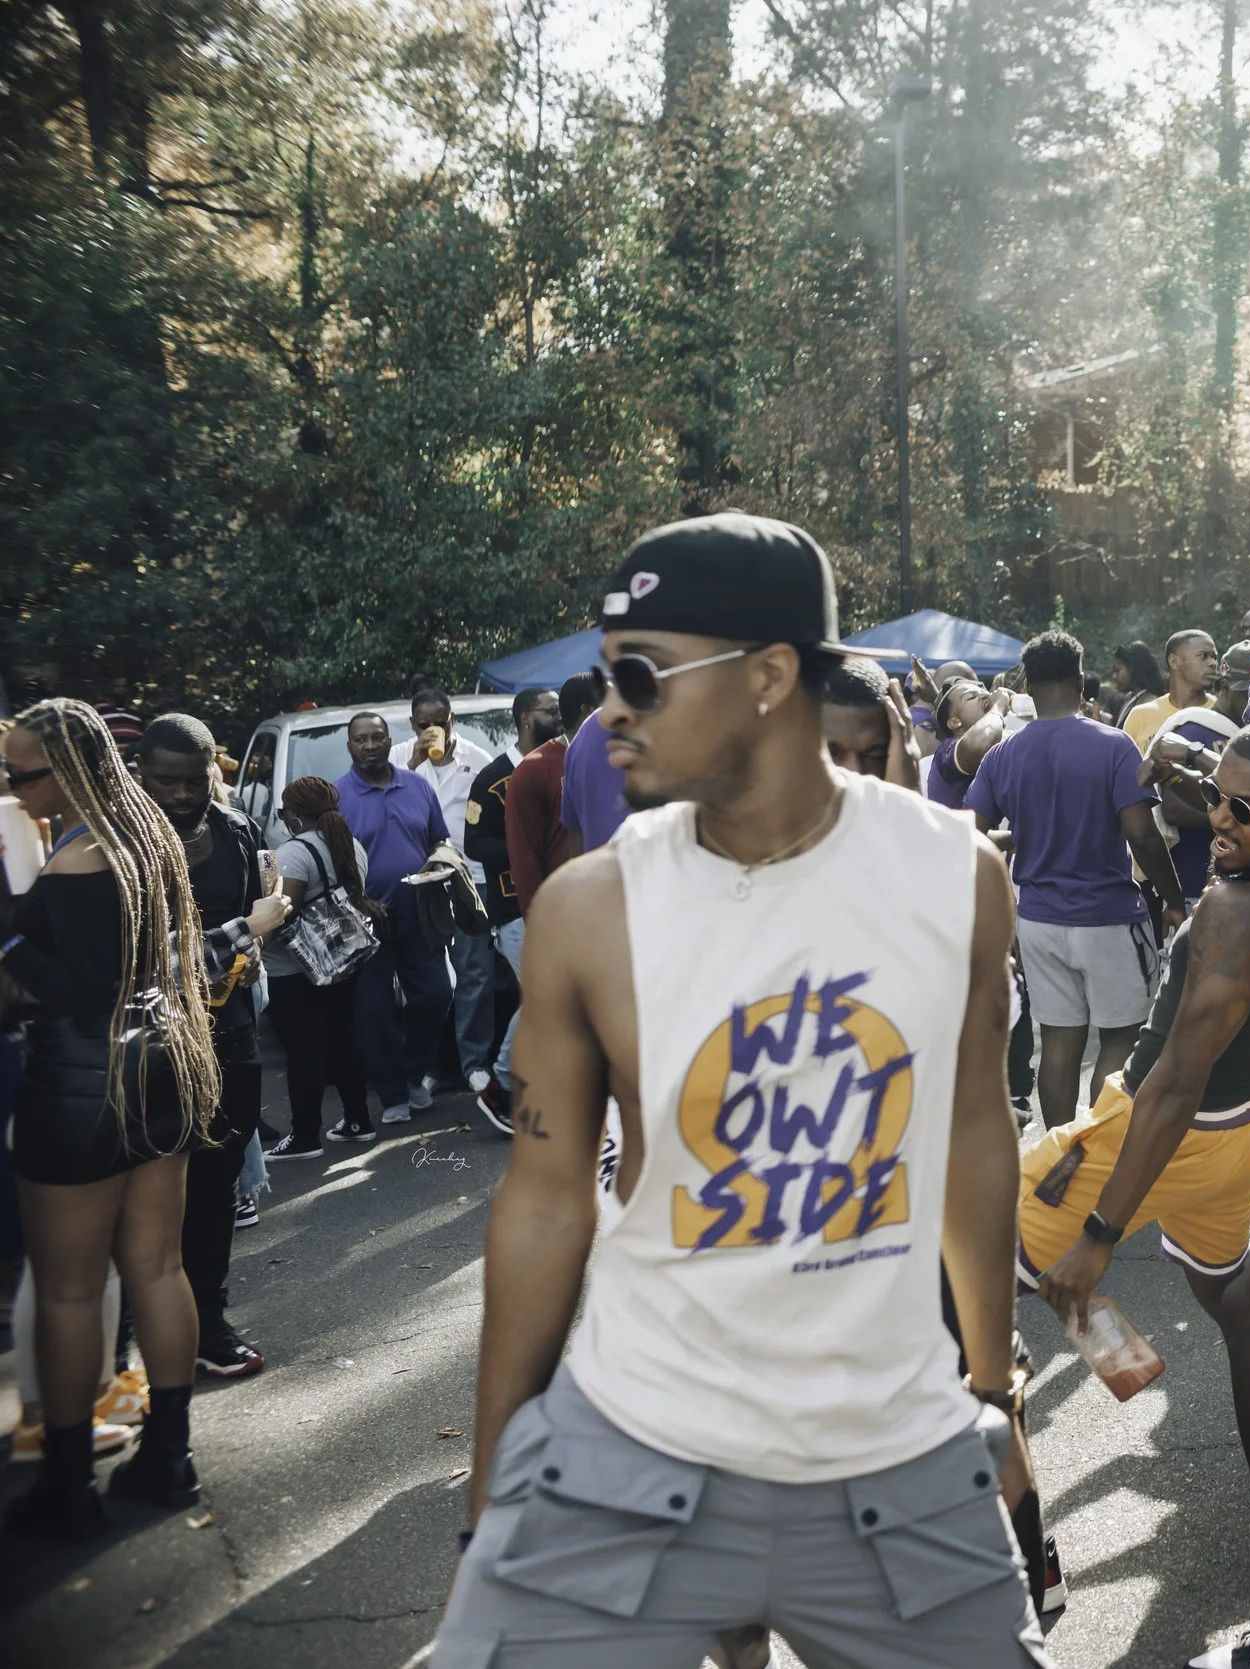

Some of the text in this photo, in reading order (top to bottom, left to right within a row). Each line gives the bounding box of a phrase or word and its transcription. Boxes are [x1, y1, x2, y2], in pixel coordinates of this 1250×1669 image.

[729, 968, 876, 1076] WE
[712, 1051, 918, 1154] OWT
[691, 1152, 901, 1256] SIDE
